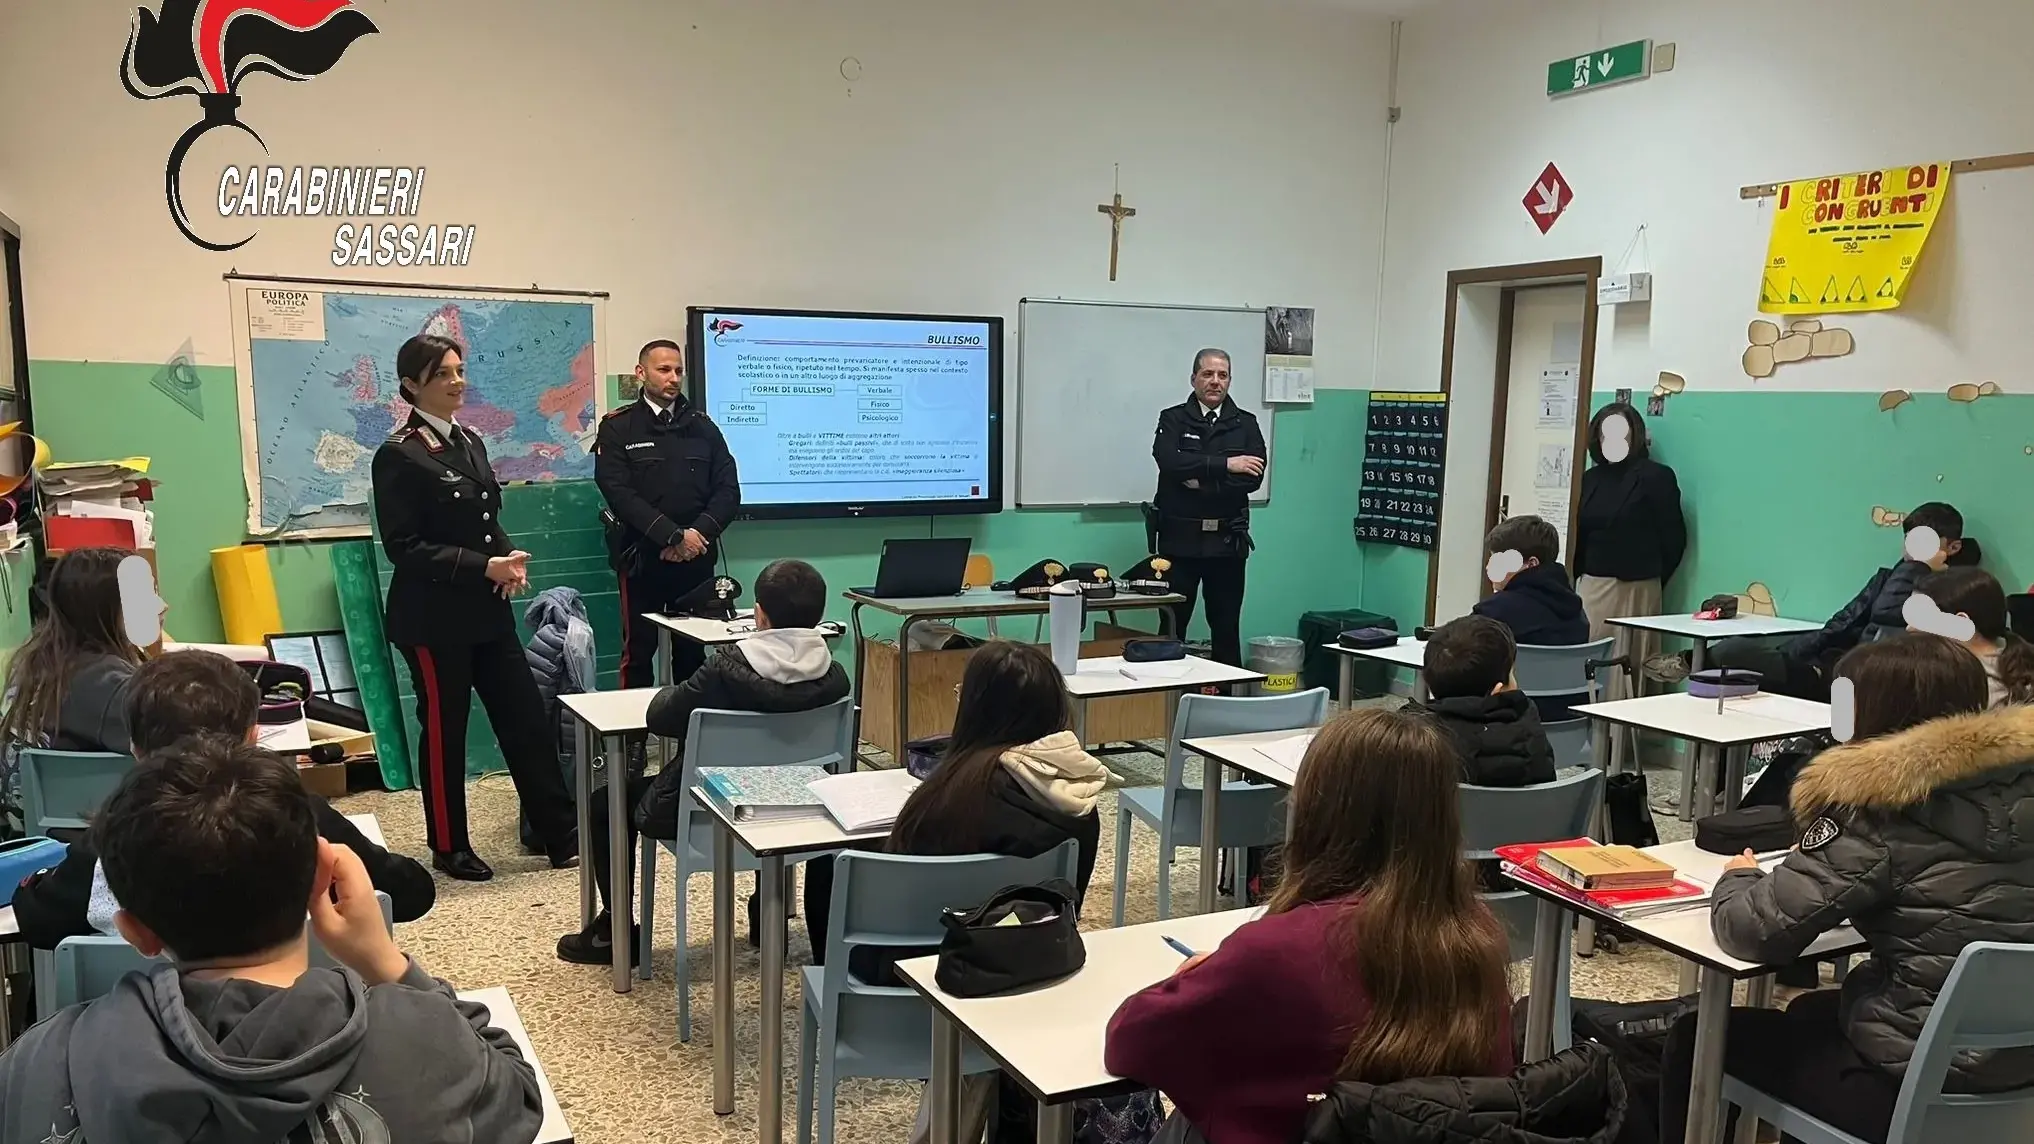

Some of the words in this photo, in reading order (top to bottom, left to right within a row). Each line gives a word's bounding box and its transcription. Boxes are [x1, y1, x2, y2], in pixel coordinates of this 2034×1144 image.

[1779, 185, 1791, 210] I
[1800, 169, 1894, 205] CRITERI
[1906, 164, 1939, 191] DI
[1800, 192, 1936, 226] CONGRUENTI
[262, 290, 309, 300] EUROPA
[266, 298, 306, 306] POLITICA
[478, 320, 571, 362] RUSSIA
[928, 335, 980, 345] BULLISMO
[1384, 415, 1389, 424] 2
[1396, 415, 1402, 426] 3
[1410, 415, 1416, 425] 4
[1422, 415, 1429, 426] 5
[1368, 443, 1375, 452] 7
[1382, 443, 1388, 454] 8
[1393, 444, 1400, 454] 9
[1406, 444, 1415, 455] 10
[1419, 445, 1427, 456] 11
[1364, 471, 1375, 480] 13
[1390, 472, 1401, 482] 15
[1404, 472, 1414, 483] 16
[1417, 474, 1426, 484] 17
[1360, 497, 1371, 508] 19
[1386, 500, 1398, 510] 21
[1400, 501, 1410, 512] 22
[1412, 502, 1423, 513] 23
[1425, 504, 1434, 515] 24
[1355, 526, 1366, 537] 25
[1369, 526, 1378, 537] 26
[1383, 528, 1396, 538] 27
[1400, 530, 1408, 541] 28
[1410, 531, 1420, 543] 29
